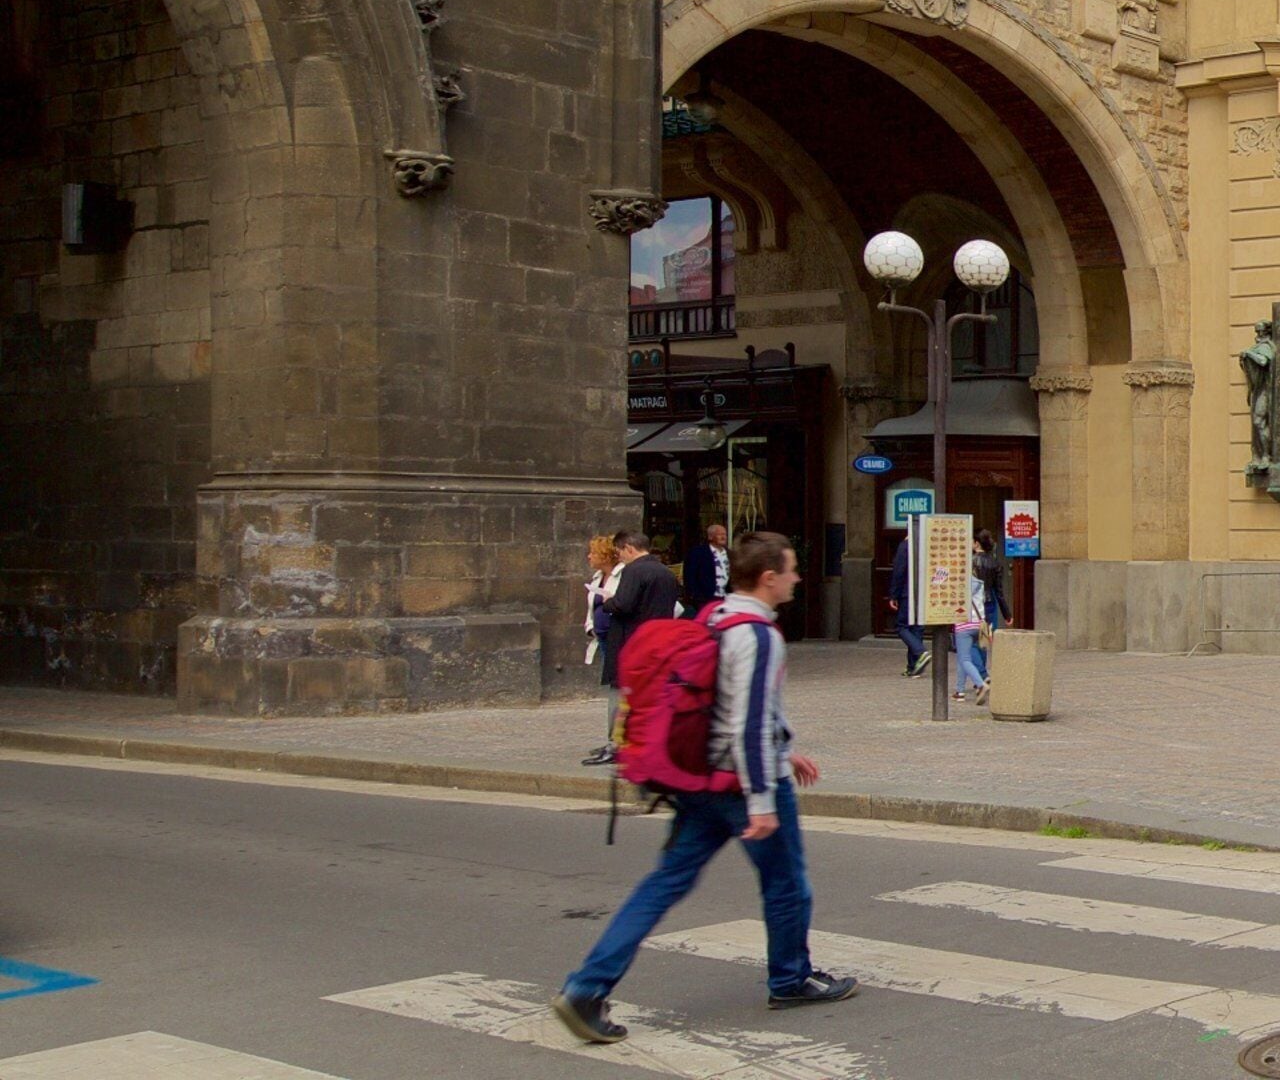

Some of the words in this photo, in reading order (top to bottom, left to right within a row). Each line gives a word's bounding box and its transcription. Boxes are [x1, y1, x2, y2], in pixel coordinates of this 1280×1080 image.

[629, 395, 668, 409] MATRAGI
[862, 459, 885, 469] CHANGE
[898, 497, 928, 512] CHANGE
